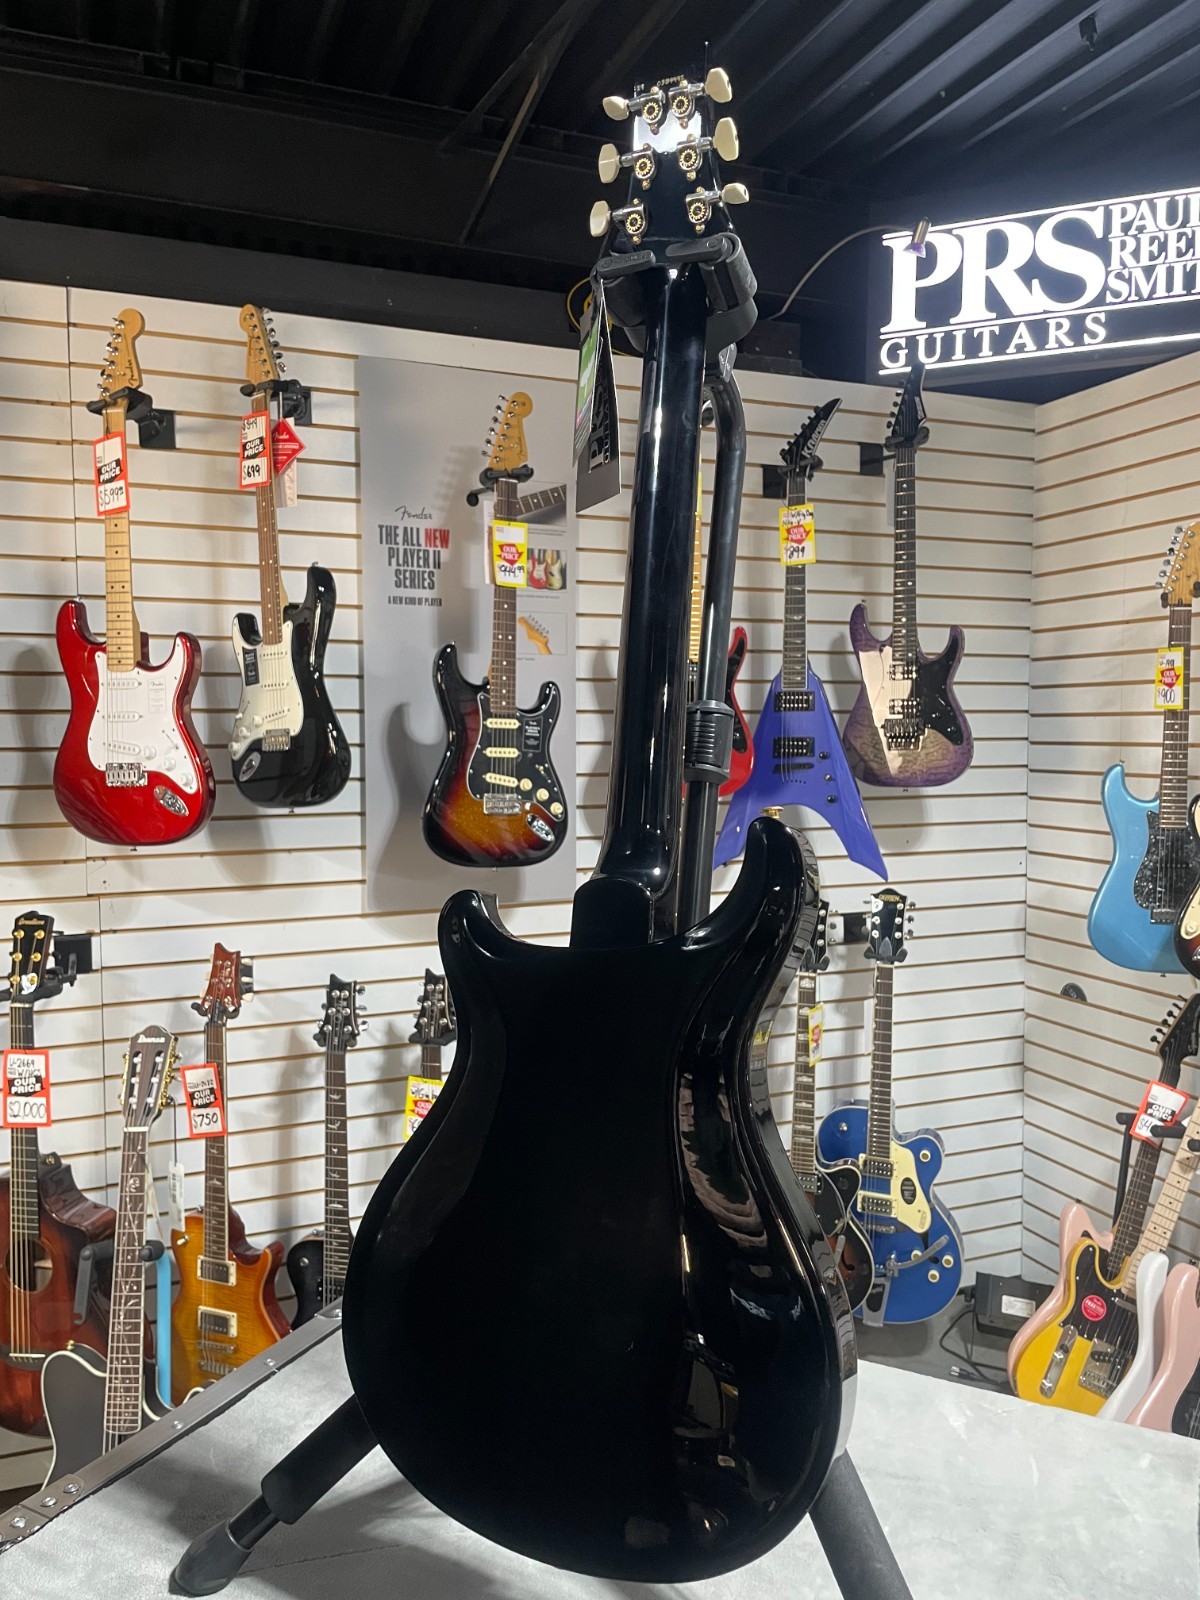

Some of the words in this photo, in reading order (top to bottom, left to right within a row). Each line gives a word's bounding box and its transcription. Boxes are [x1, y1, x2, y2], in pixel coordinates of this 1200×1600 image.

[1107, 226, 1200, 271] REE
[880, 206, 1106, 333] PRS
[879, 312, 1107, 370] GUITARS
[244, 443, 264, 458] PRICE
[245, 438, 260, 450] OUR
[100, 467, 121, 483] PRICE
[101, 461, 117, 474] OUR
[242, 464, 261, 481] $699
[394, 505, 433, 521] Fender
[378, 524, 400, 546] THE
[402, 526, 422, 547] ALL
[424, 527, 450, 549] NEW
[501, 552, 520, 560] PRICE
[502, 545, 517, 553] OUR
[387, 546, 430, 569] PLAYER
[432, 549, 441, 570] II
[394, 568, 435, 590] SERIES
[392, 595, 404, 605] NEW
[404, 596, 417, 606] KIND
[417, 597, 424, 606] OF
[424, 597, 442, 607] PLAYER
[1161, 676, 1176, 684] PRICE
[1158, 688, 1175, 704] $900
[11, 1083, 41, 1094] PRICE
[14, 1077, 36, 1086] OUR
[193, 1095, 215, 1107] PRICE
[194, 1090, 211, 1099] OUR
[9, 1101, 47, 1119] $2,000
[1147, 1108, 1172, 1122] PRICE
[1152, 1104, 1172, 1115] OUR
[193, 1112, 219, 1130] $750
